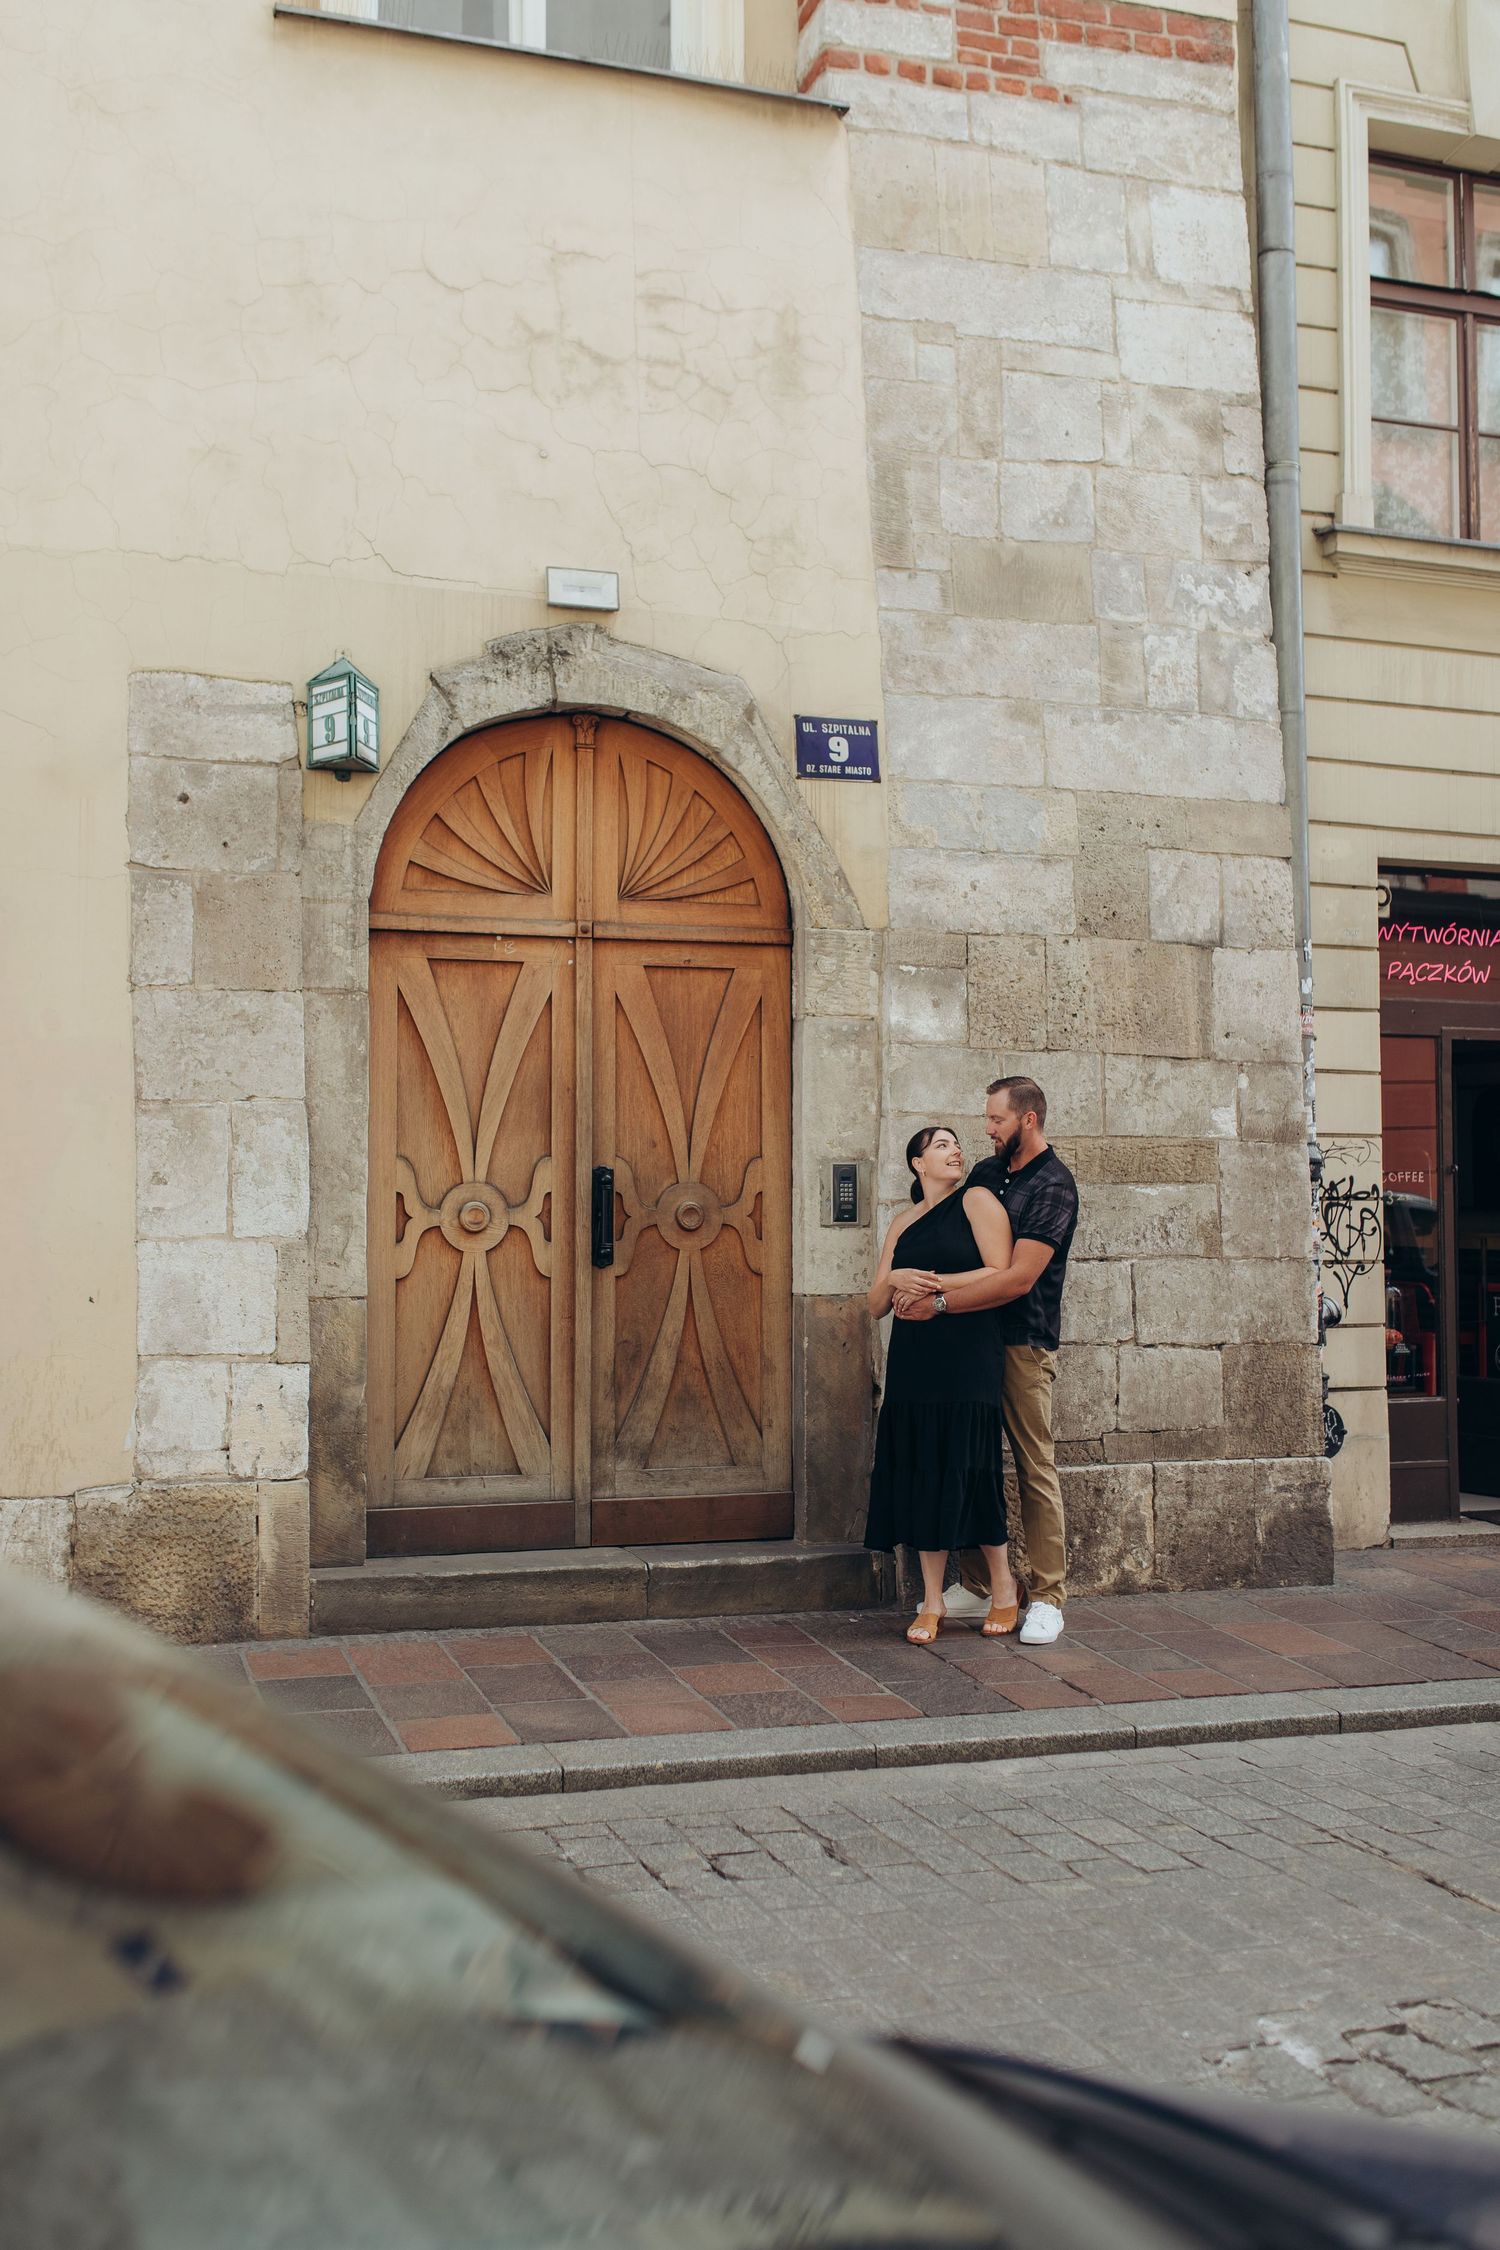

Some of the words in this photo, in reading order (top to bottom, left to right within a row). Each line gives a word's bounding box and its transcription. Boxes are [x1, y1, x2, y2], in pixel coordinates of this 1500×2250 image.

[325, 715, 335, 744] 9
[802, 722, 817, 733] UL.
[821, 723, 871, 736] SZPITALNA
[828, 736, 849, 763] 9
[819, 765, 841, 774] STARE
[845, 766, 872, 776] MIASTO
[1387, 960, 1491, 985] PĄCZKÓW
